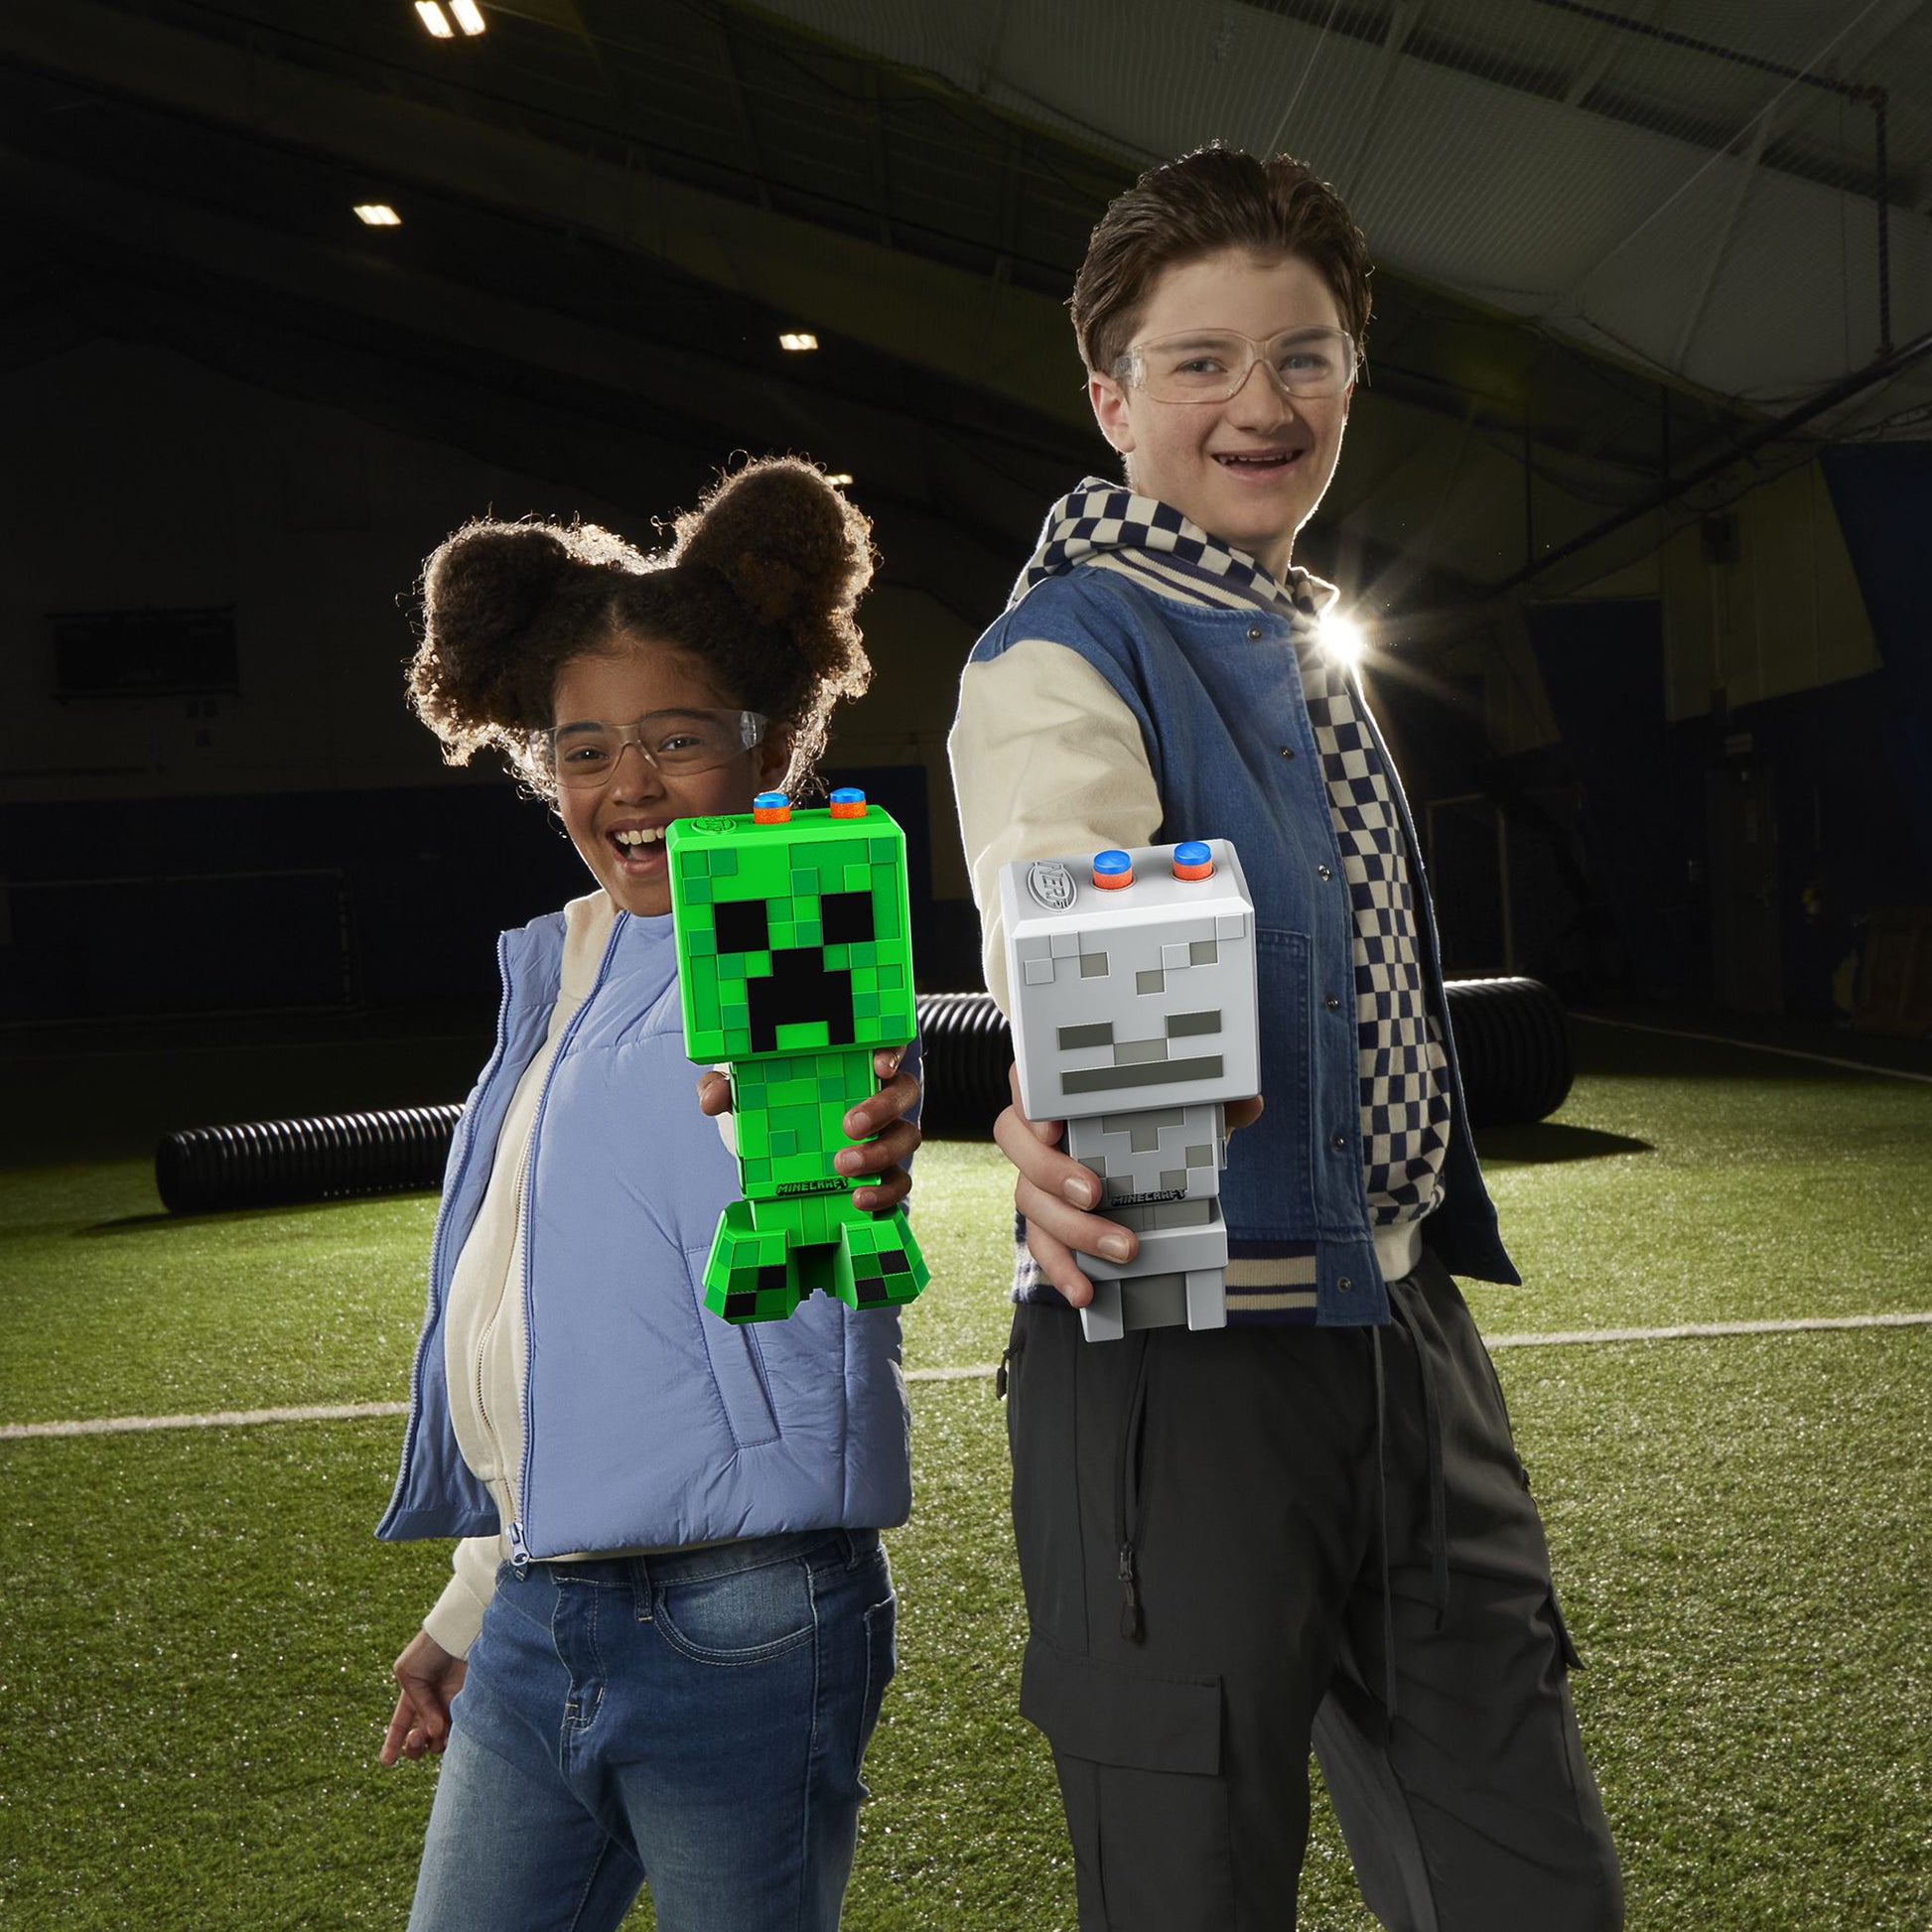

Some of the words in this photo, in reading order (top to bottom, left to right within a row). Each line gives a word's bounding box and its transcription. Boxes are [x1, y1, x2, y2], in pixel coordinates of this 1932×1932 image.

[1032, 860, 1070, 909] NERF
[776, 1177, 849, 1196] MINECRAFT
[1112, 1188, 1185, 1206] MINECRAFT
